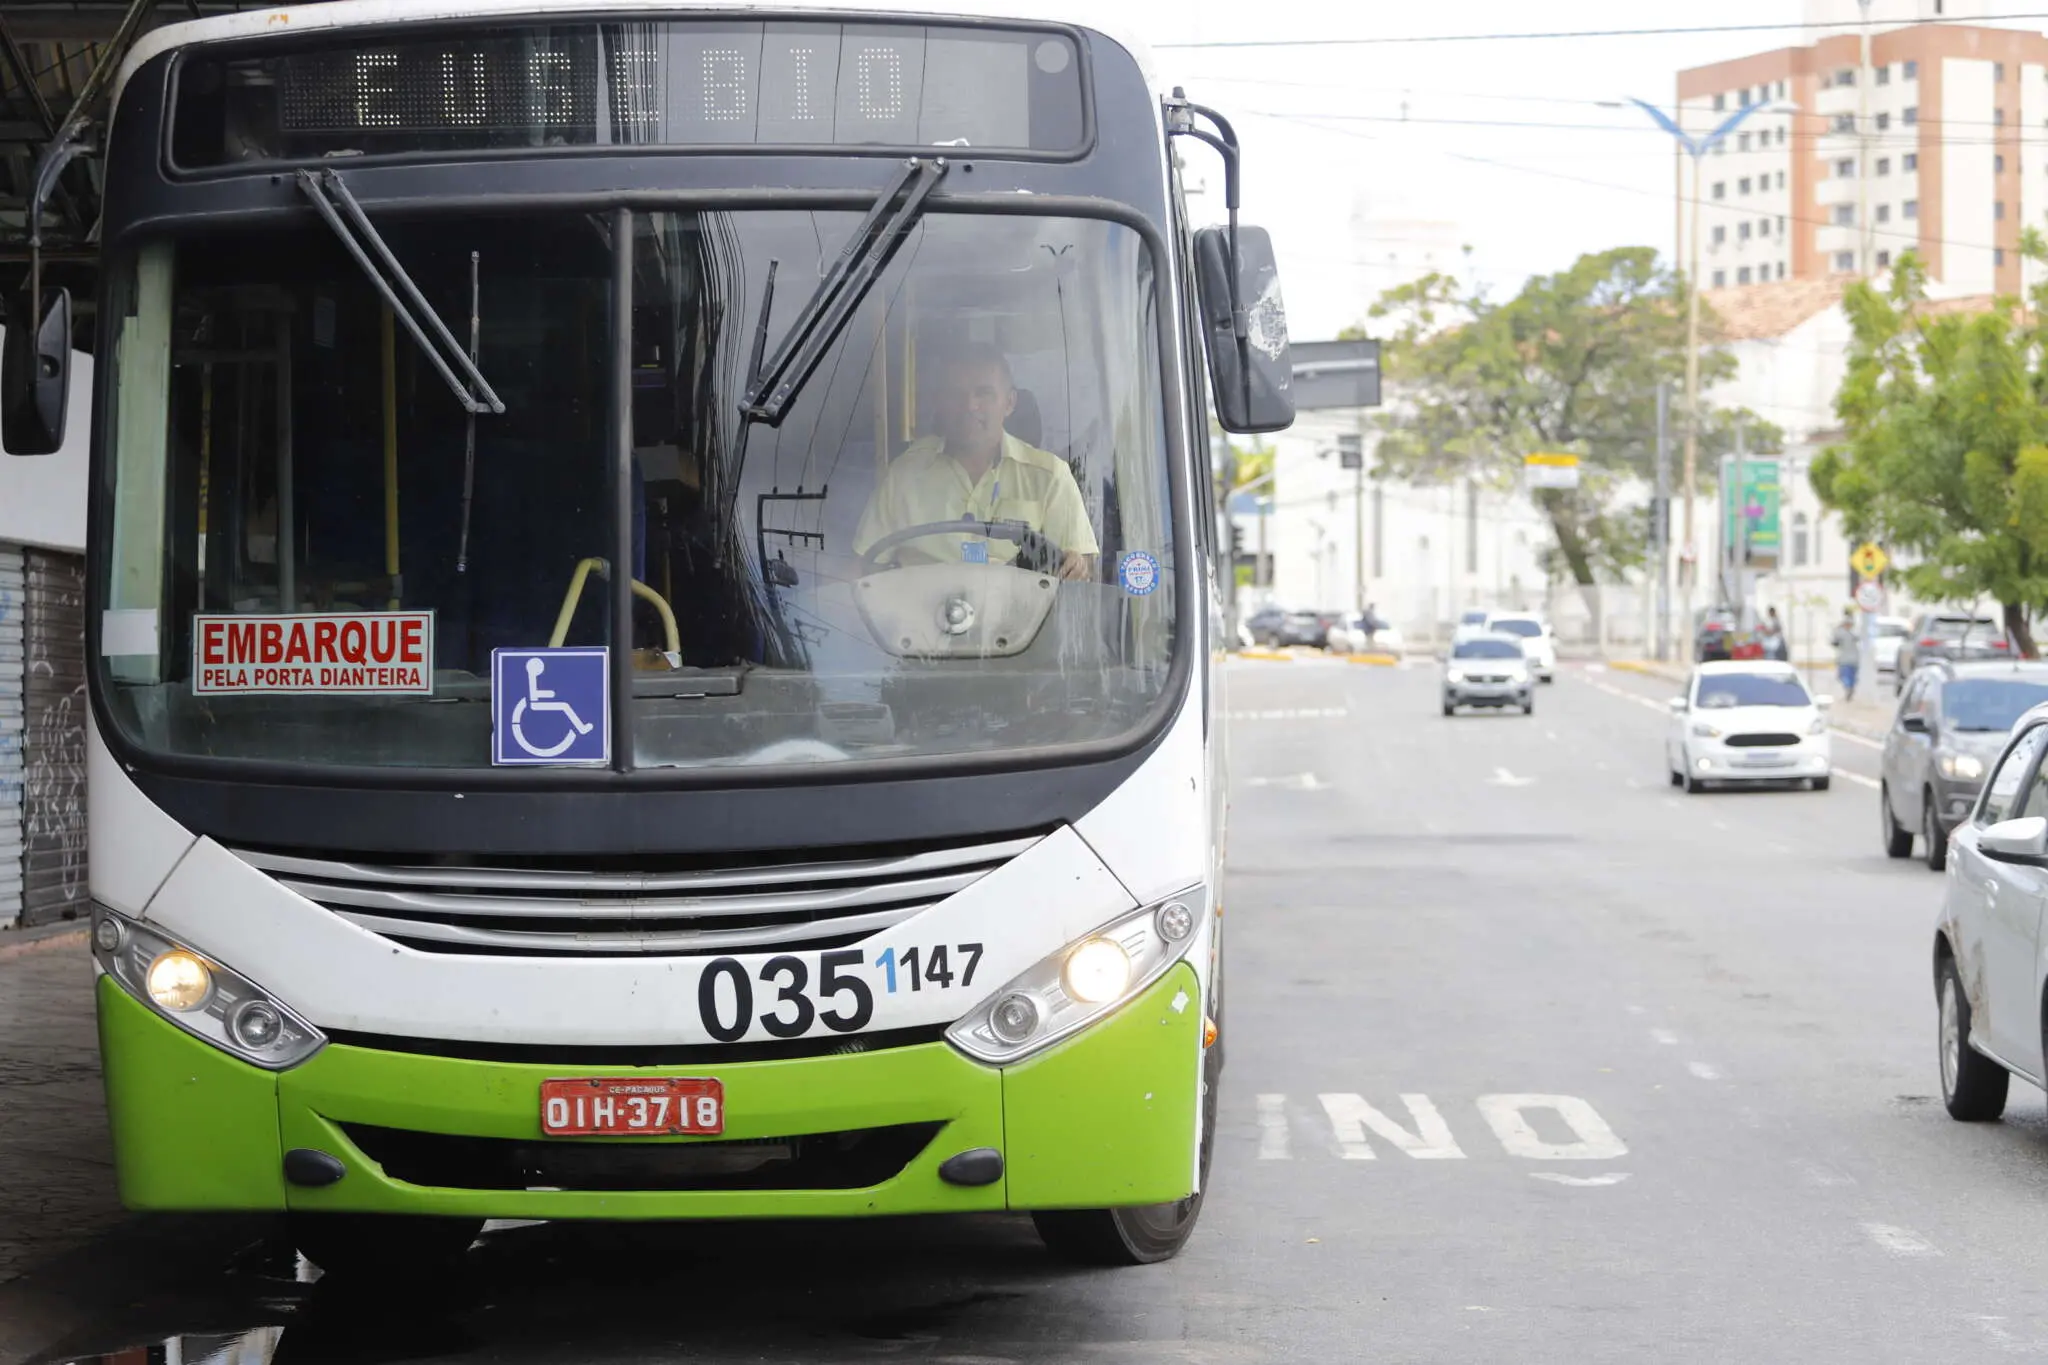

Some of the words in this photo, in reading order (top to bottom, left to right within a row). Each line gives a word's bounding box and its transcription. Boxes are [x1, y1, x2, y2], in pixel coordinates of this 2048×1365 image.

[203, 620, 423, 666] EMBARQUE
[203, 669, 248, 687] PELA
[254, 668, 314, 686] PORTA
[320, 667, 421, 686] DIANTEIRA
[698, 949, 874, 1042] 035
[547, 1096, 718, 1128] OIH-3718
